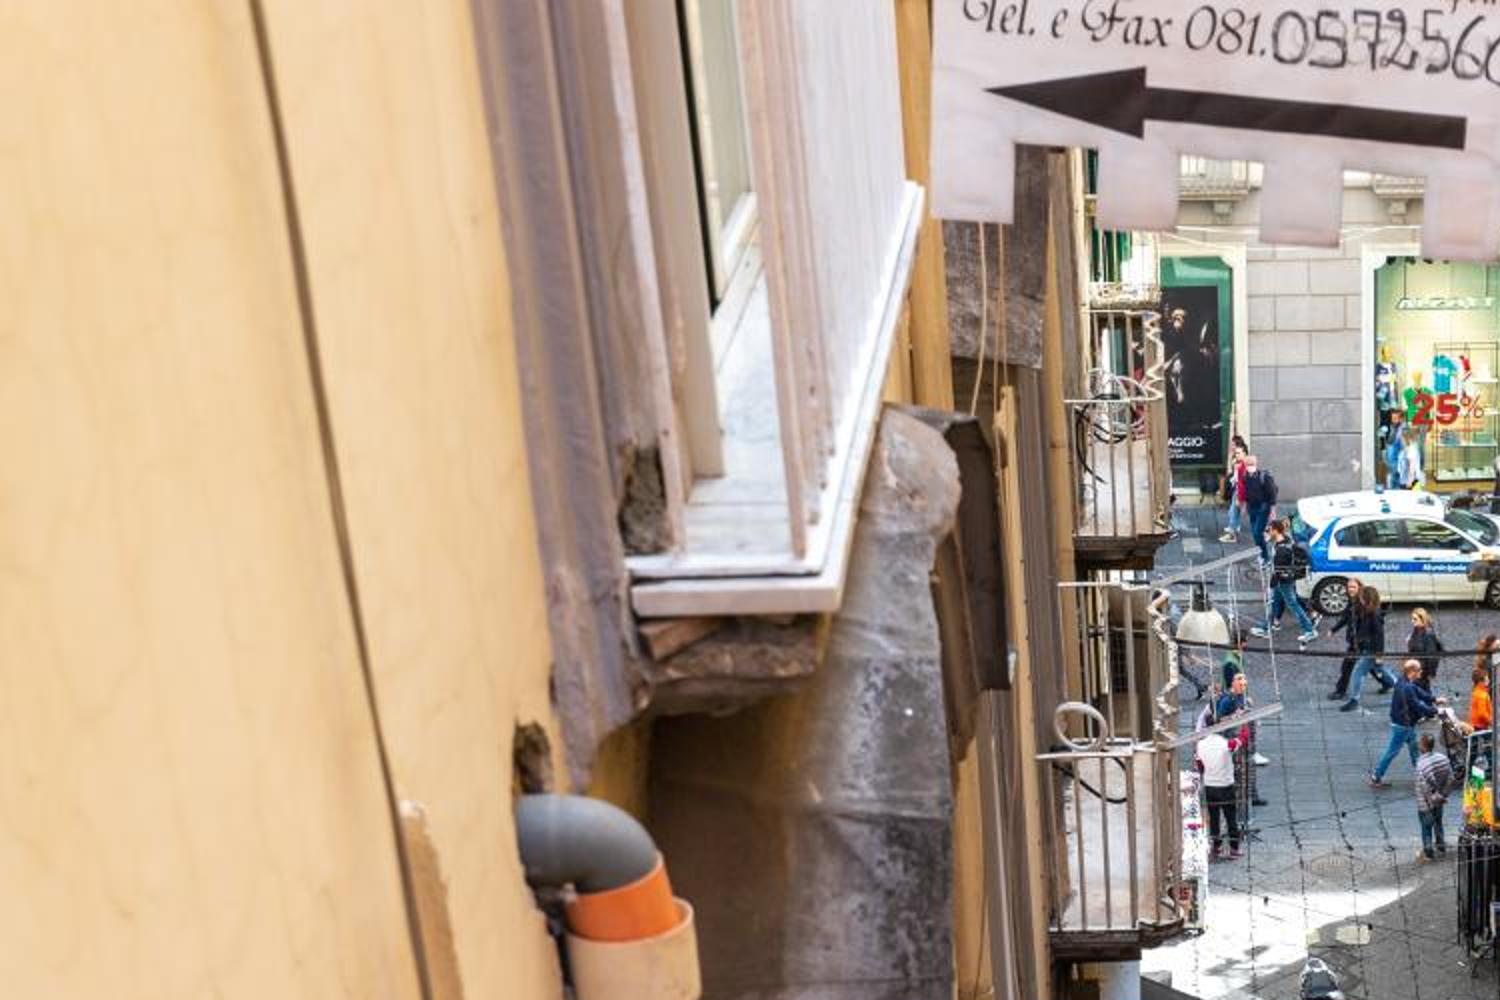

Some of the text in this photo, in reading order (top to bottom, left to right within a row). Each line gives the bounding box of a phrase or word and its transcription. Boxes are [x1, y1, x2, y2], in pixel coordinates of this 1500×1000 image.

[1050, 8, 1068, 38] e
[1081, 0, 1172, 47] Fax
[1168, 436, 1203, 447] AGGIO
